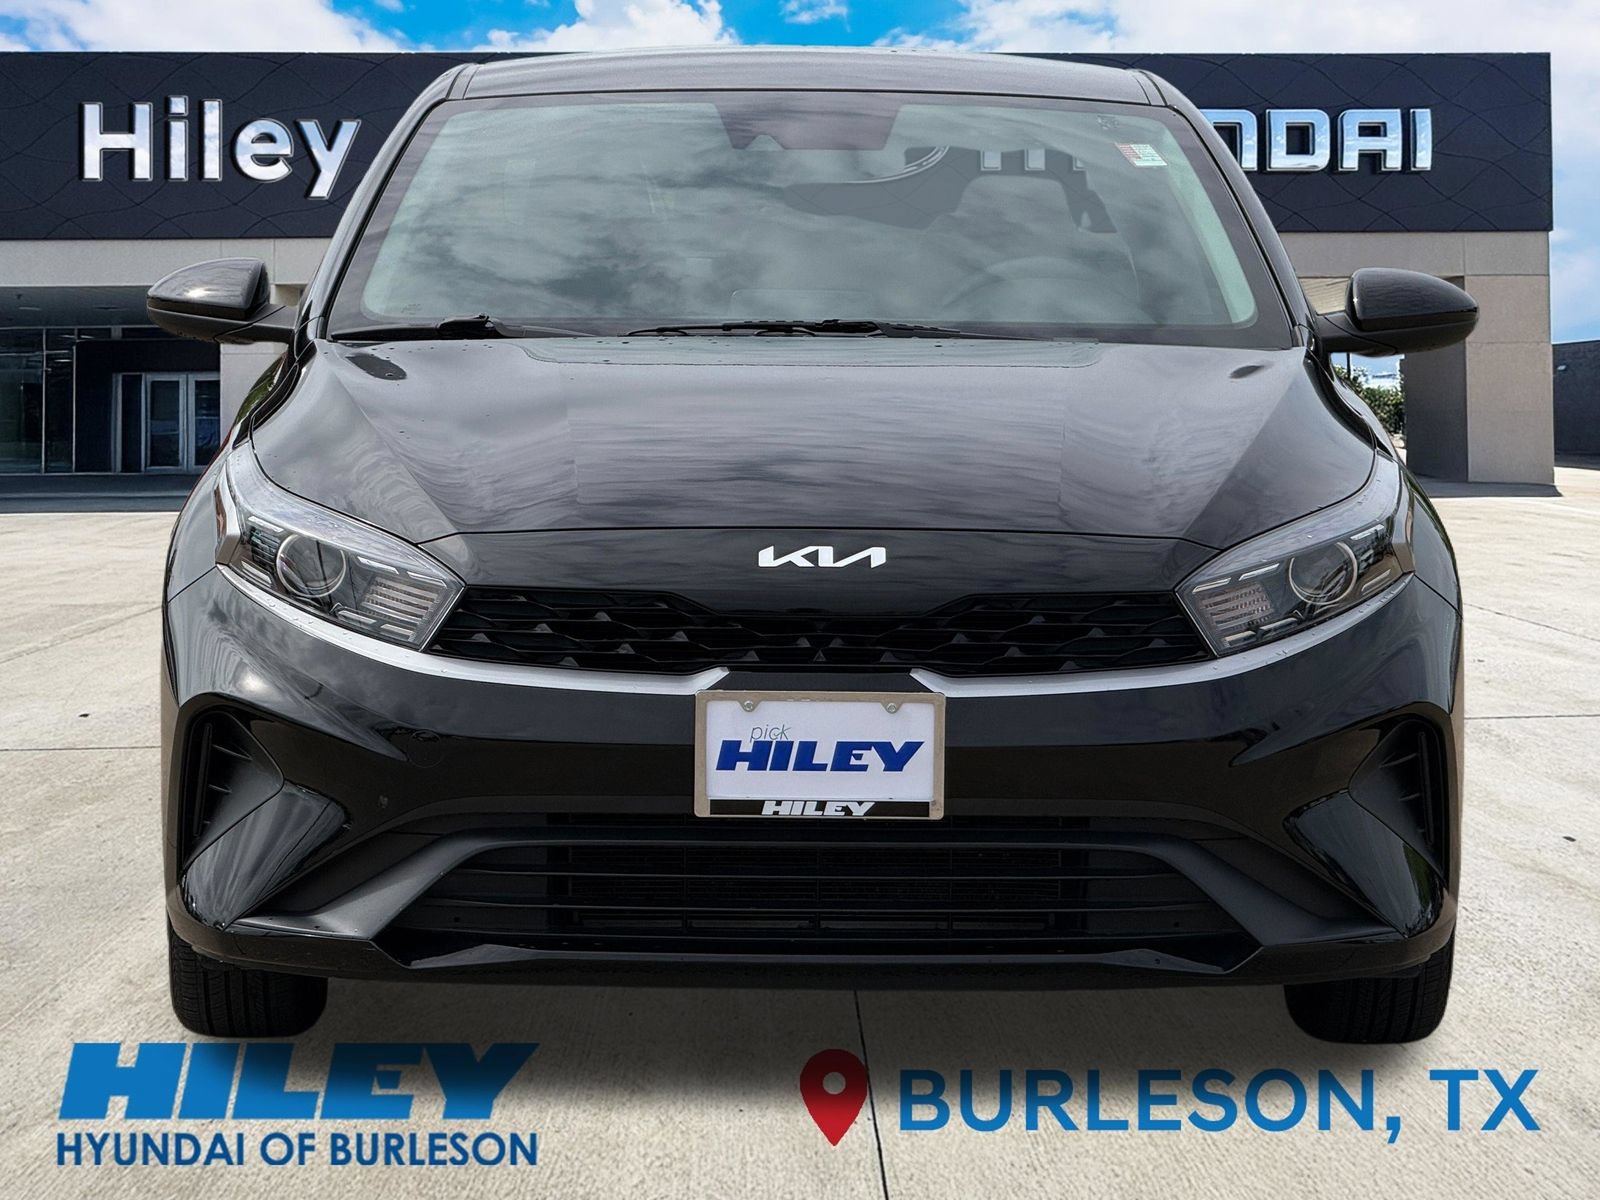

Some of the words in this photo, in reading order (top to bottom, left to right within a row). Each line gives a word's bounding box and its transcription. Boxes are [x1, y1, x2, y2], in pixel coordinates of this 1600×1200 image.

[80, 95, 361, 200] Hiley
[1200, 108, 1432, 171] NDAI
[758, 545, 887, 568] KIA
[750, 723, 791, 742] pick
[716, 740, 925, 772] HILEY
[761, 800, 876, 818] HILEY
